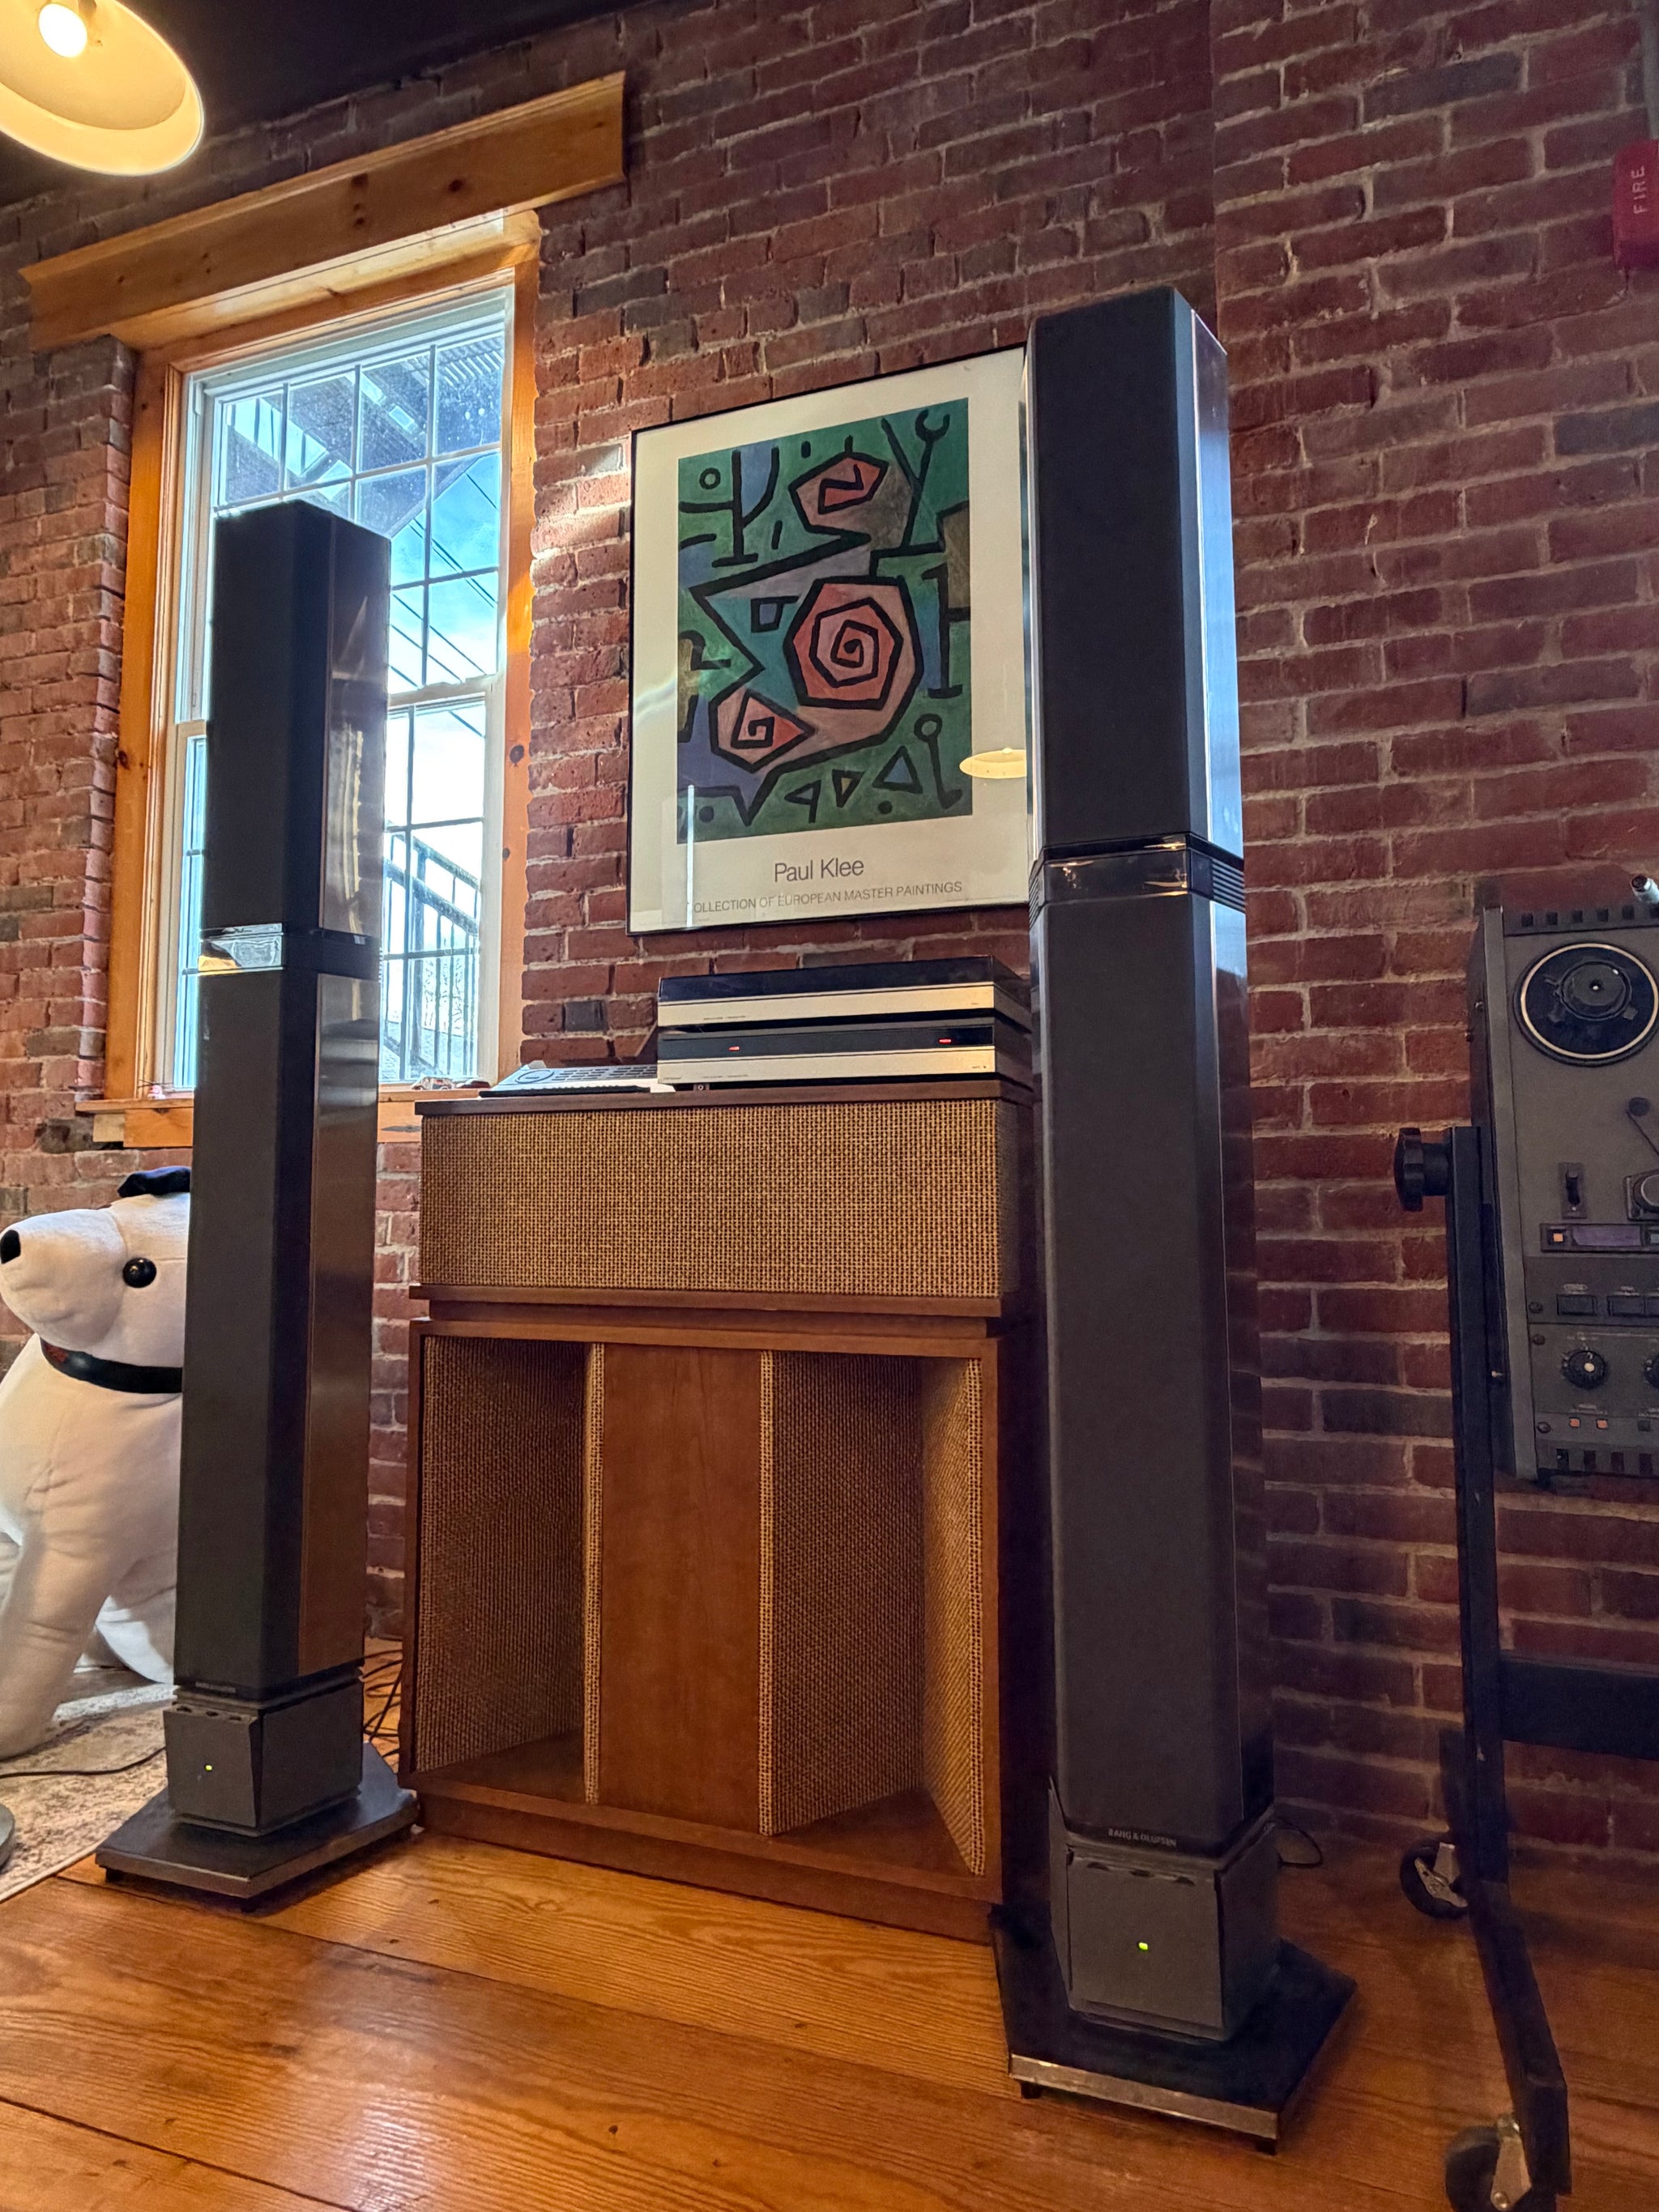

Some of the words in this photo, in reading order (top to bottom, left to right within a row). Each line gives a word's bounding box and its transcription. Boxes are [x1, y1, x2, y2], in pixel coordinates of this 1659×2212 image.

[1631, 165, 1648, 215] FIRE
[774, 859, 813, 883] Paul
[820, 858, 864, 880] Klee
[687, 897, 757, 914] OLLECTION
[759, 896, 775, 908] OF
[778, 891, 841, 907] EUROPEAN
[844, 886, 893, 901] MASTER
[896, 881, 963, 897] PAINTINGS
